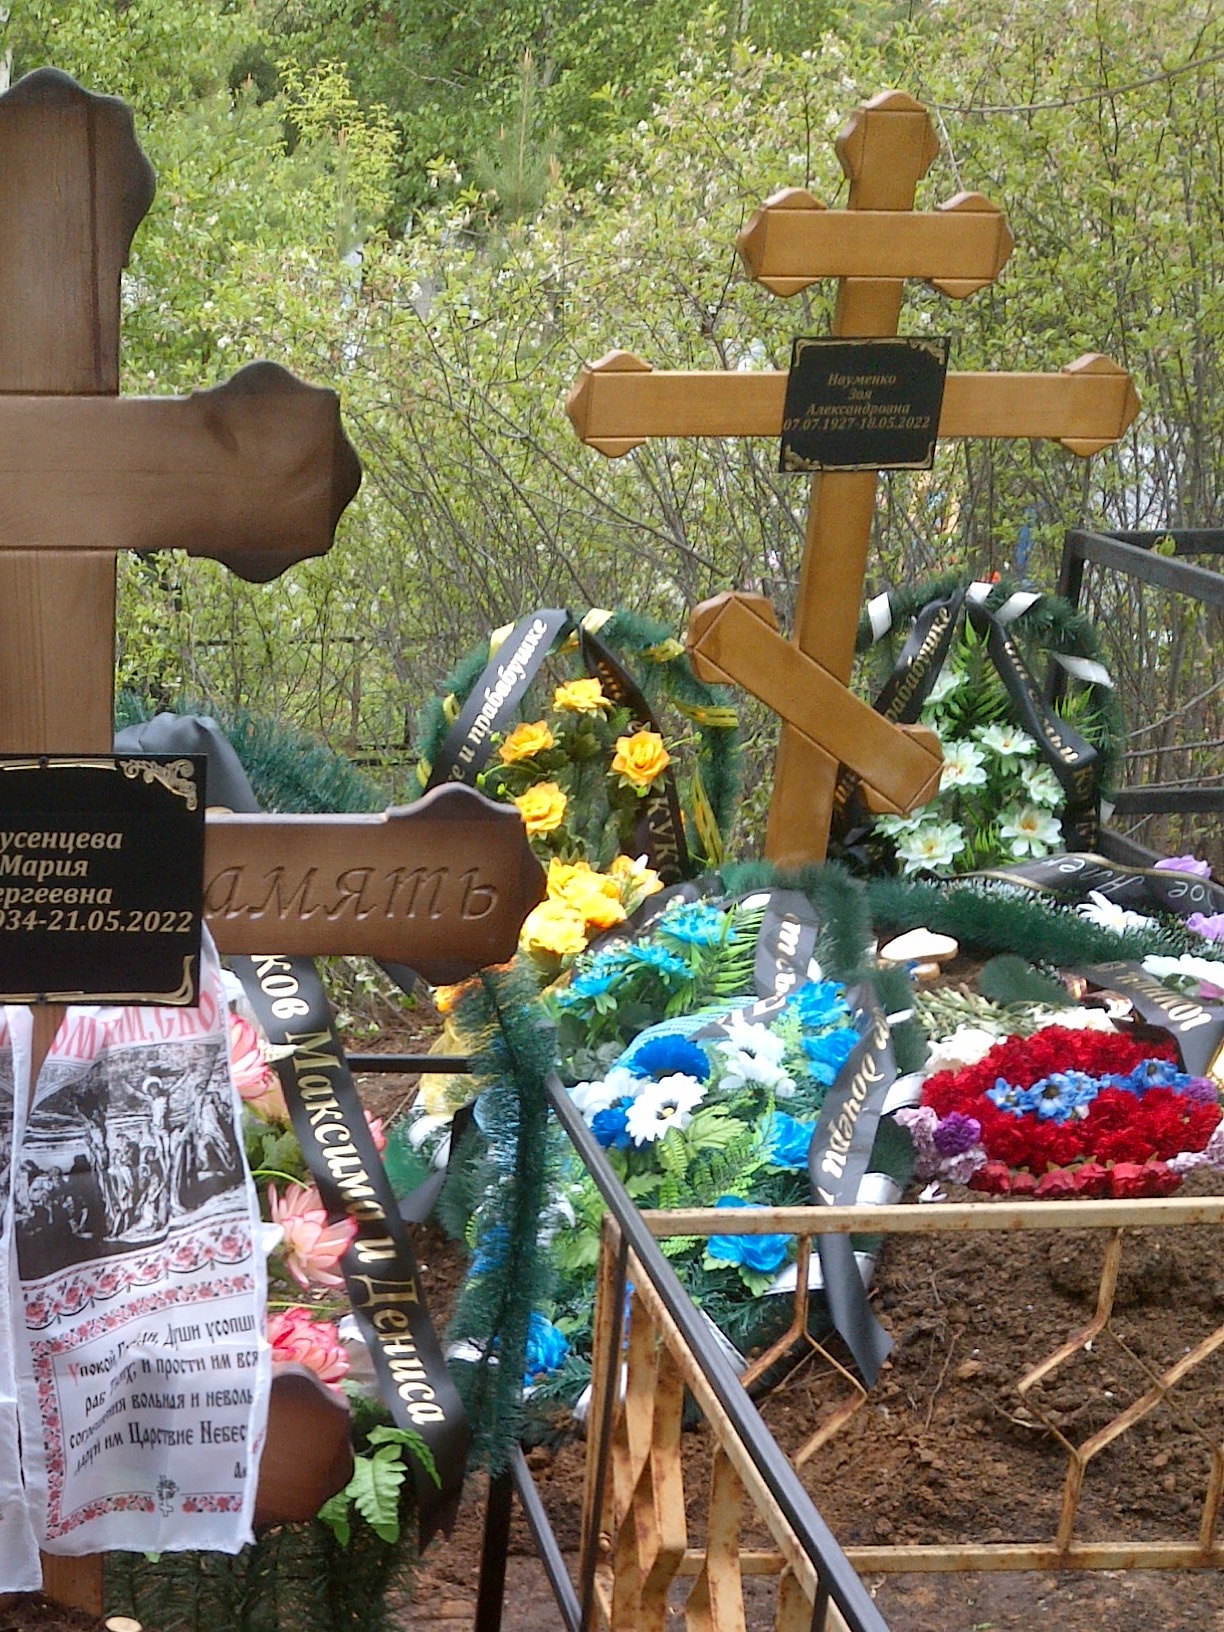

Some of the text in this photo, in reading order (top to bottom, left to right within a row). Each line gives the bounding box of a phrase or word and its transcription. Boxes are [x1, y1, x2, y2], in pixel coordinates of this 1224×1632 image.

[827, 372, 897, 388] Науменко
[847, 388, 874, 401] Зоя
[805, 402, 911, 417] Александровна
[467, 617, 549, 747] прабабушке
[203, 865, 500, 921] амять
[249, 954, 448, 1426] ков Максима и Дениса
[205, 1314, 255, 1345] усопш
[84, 1390, 107, 1418] раб
[141, 1358, 152, 1374] и
[156, 1357, 207, 1381] прости
[210, 1352, 232, 1371] им
[236, 1350, 259, 1369] вся
[130, 1392, 186, 1410] вольная
[190, 1391, 200, 1409] и
[205, 1388, 254, 1409] неволь
[103, 1431, 124, 1450] им
[127, 1420, 195, 1451] Царствие
[199, 1420, 248, 1445] Небес
